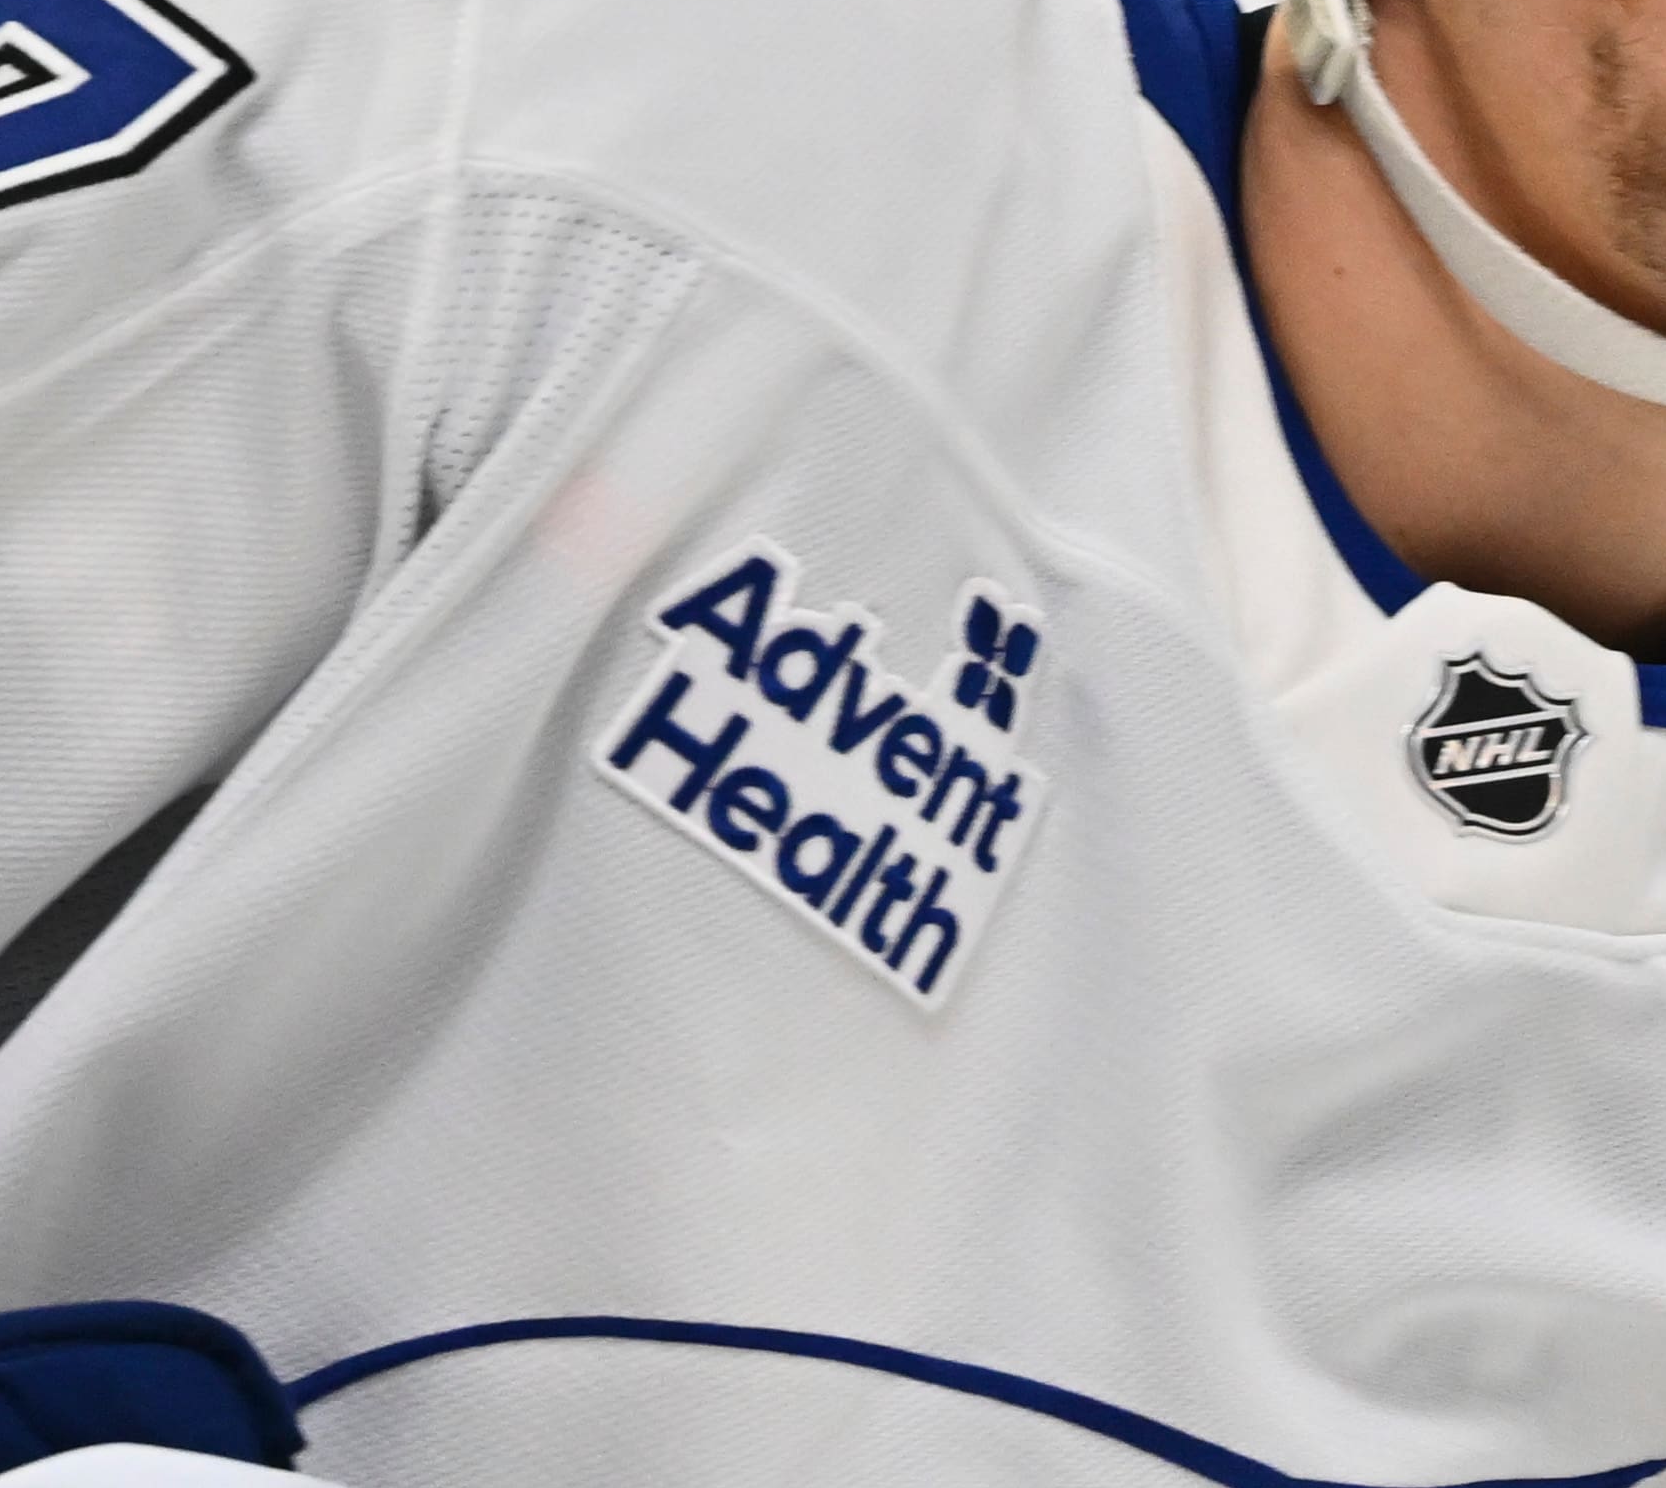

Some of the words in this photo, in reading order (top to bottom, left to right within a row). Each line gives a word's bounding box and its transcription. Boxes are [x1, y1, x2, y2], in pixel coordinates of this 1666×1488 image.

[607, 671, 962, 995] Health
[659, 555, 1023, 873] Advent
[1433, 725, 1553, 776] NHL
